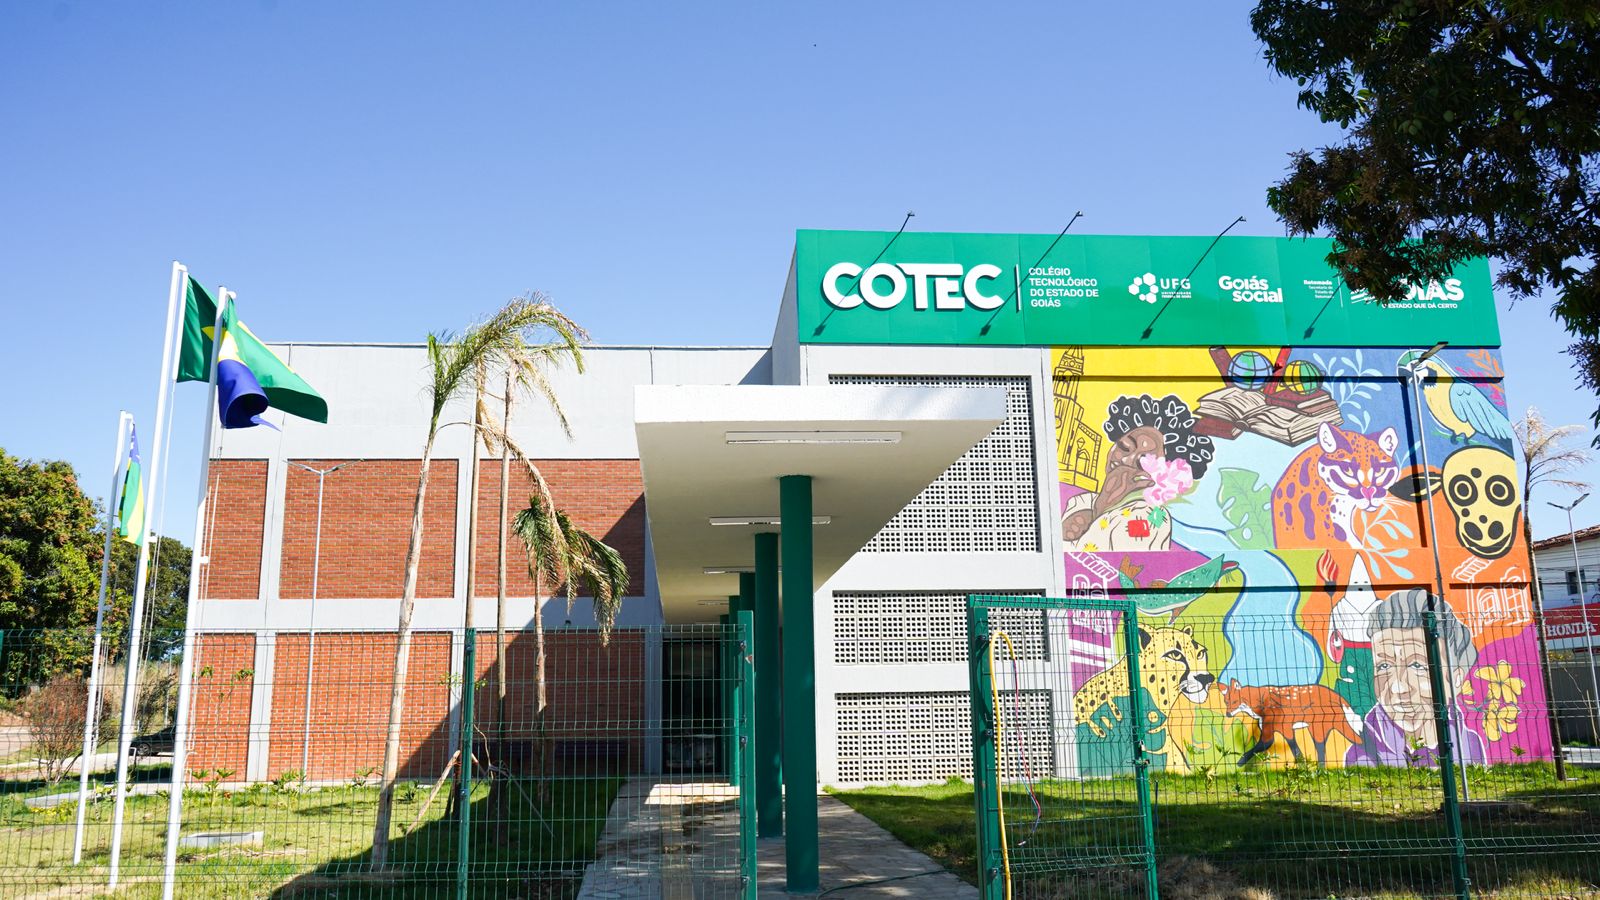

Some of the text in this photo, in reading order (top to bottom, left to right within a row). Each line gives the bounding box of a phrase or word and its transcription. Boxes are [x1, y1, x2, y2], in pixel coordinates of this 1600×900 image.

[1028, 266, 1071, 276] COLÉGIO
[822, 262, 1005, 309] COTEC
[1028, 277, 1098, 287] TECNOLÓGICO
[1160, 278, 1191, 290] UFG
[1030, 288, 1099, 297] DO ESTADO DE
[1232, 288, 1284, 303] social
[1030, 298, 1062, 307] GOIÁS
[1546, 621, 1597, 637] HONDA
